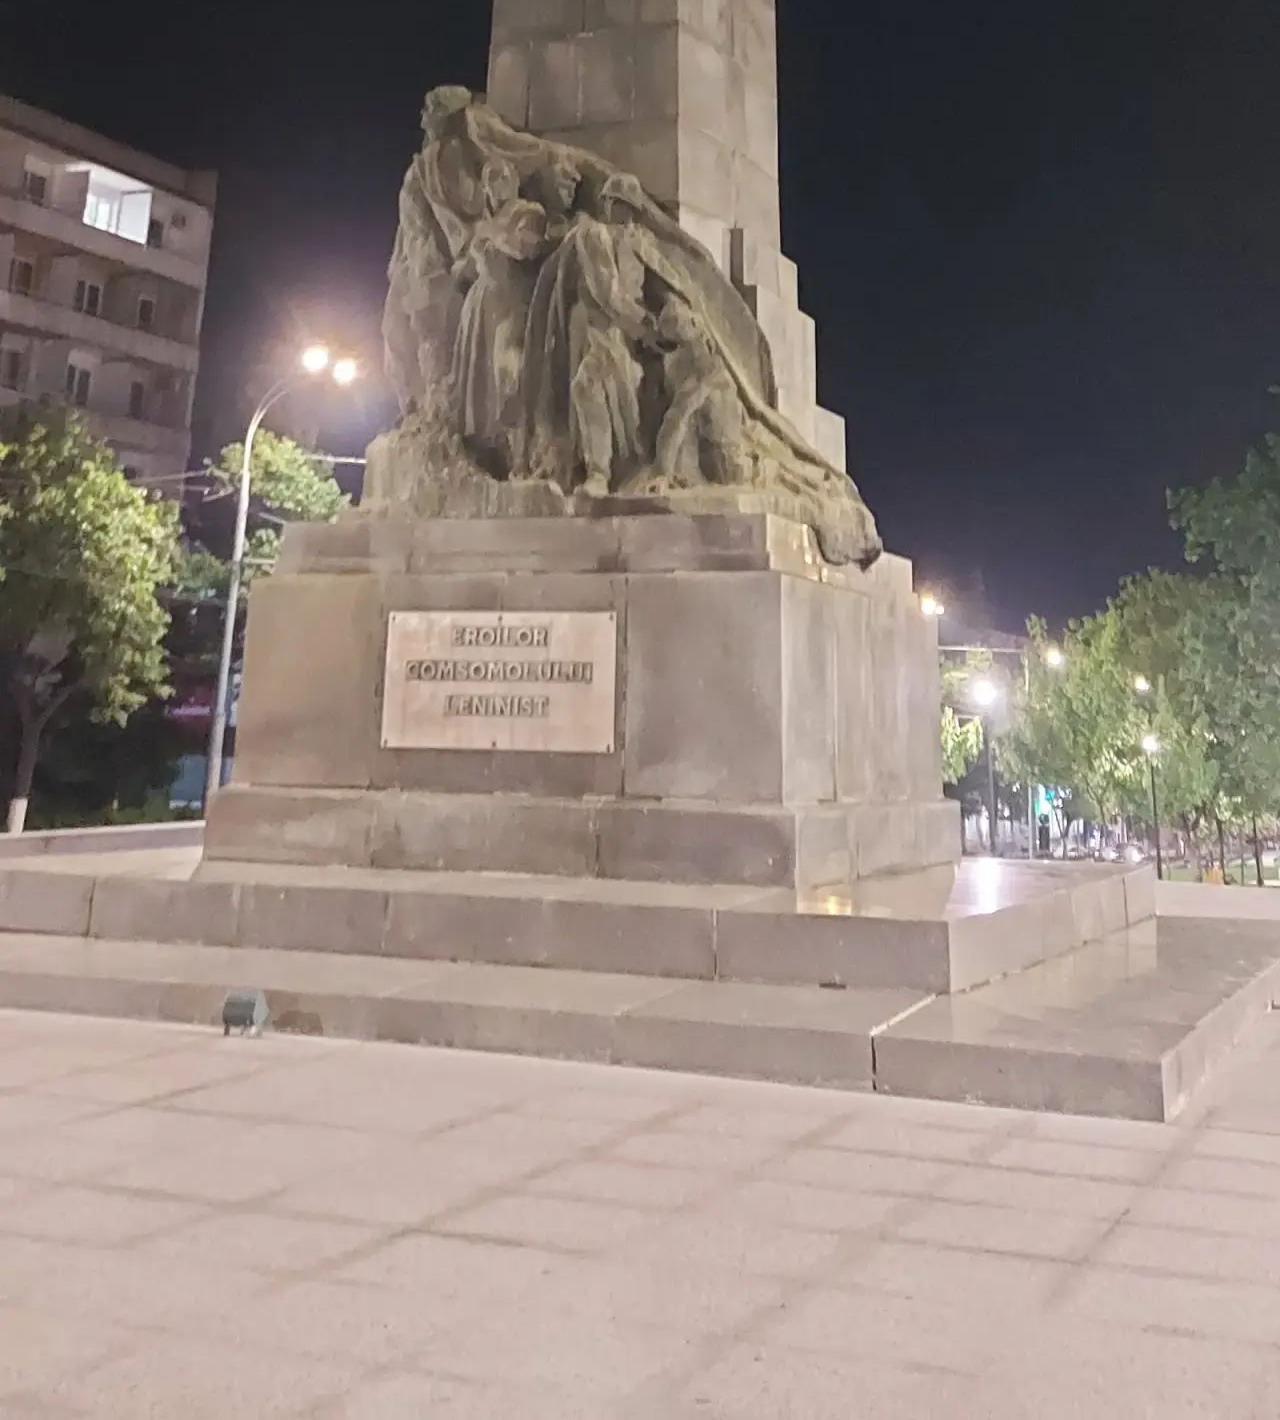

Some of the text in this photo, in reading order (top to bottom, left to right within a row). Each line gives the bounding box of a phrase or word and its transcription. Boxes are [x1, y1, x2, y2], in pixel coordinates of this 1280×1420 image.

[453, 627, 548, 647] EROILOR
[405, 660, 594, 683] COMSOMOLULUI
[445, 695, 549, 716] LENINIST
